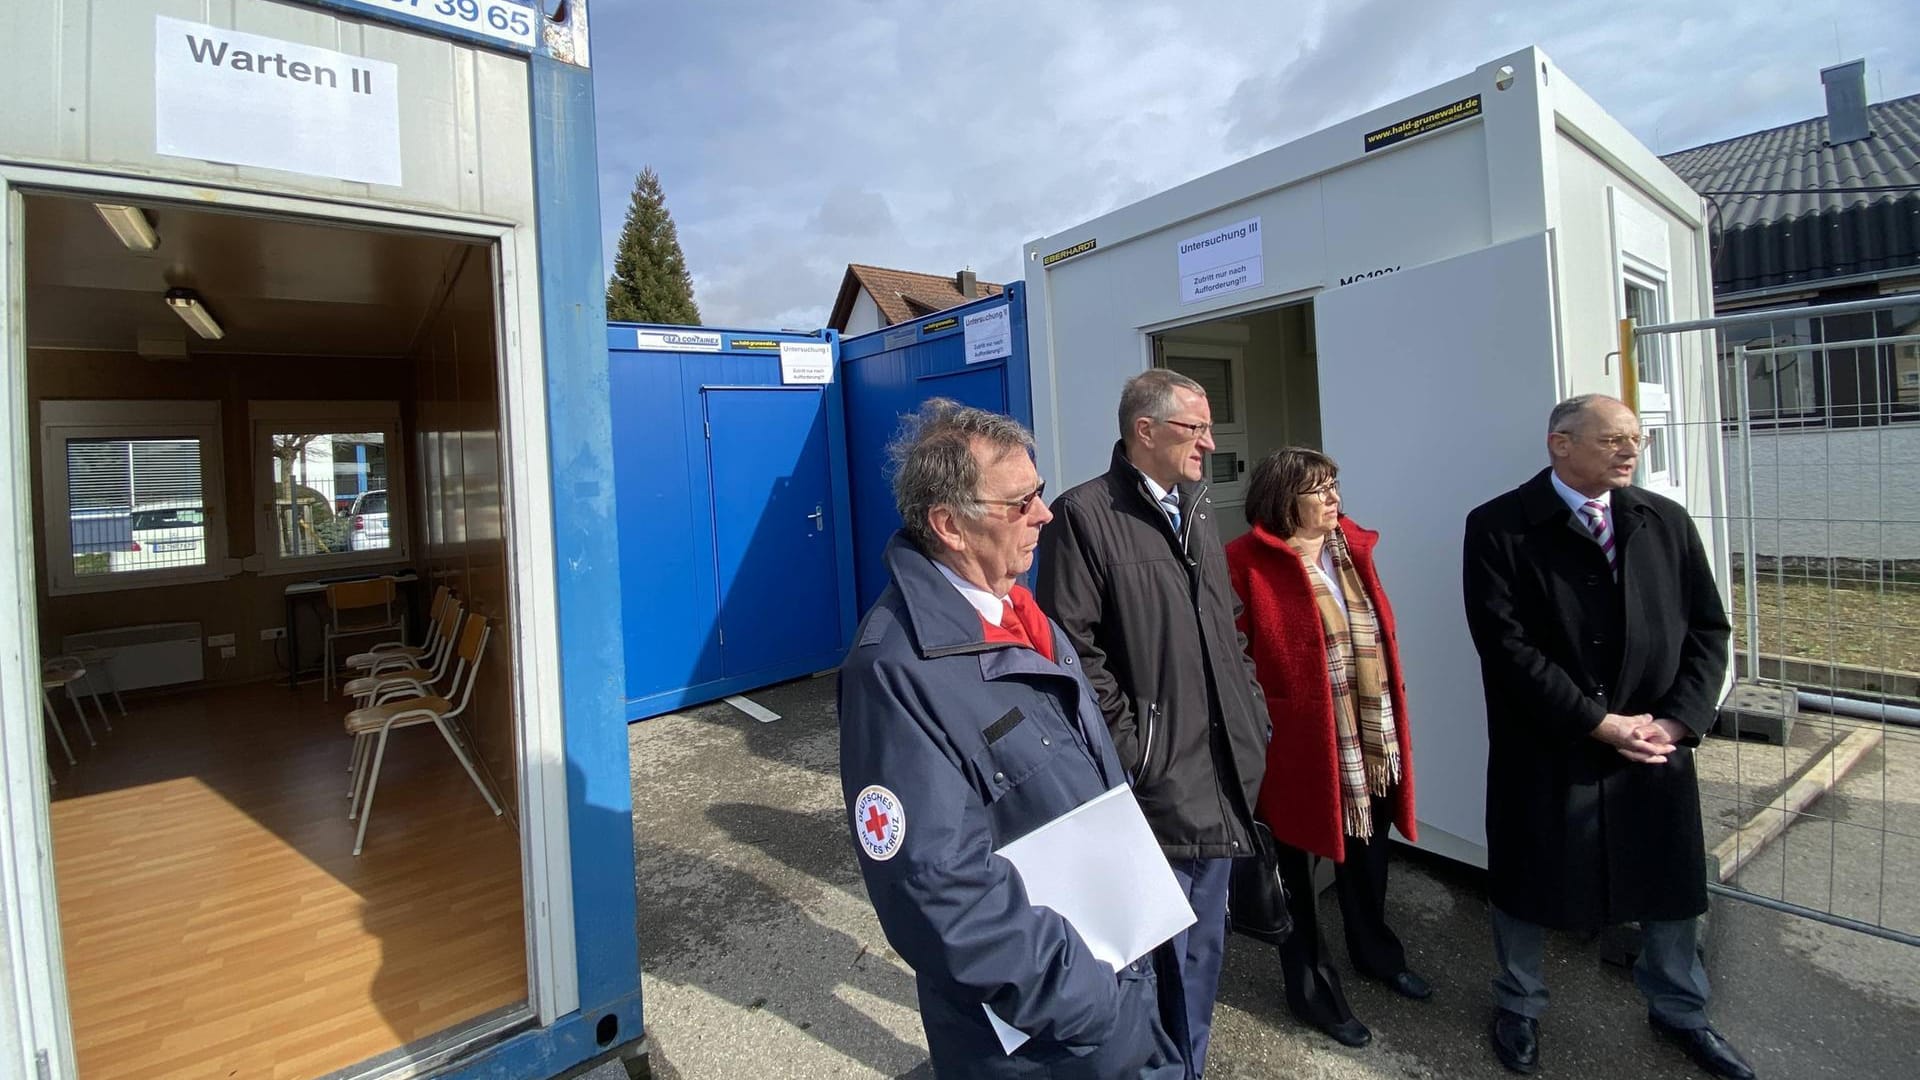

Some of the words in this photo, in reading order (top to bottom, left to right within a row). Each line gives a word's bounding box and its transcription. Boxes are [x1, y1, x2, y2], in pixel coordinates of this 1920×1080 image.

[434, 0, 479, 22] 39
[487, 6, 530, 36] 65
[186, 34, 337, 88] Warten
[352, 68, 372, 95] II
[1367, 99, 1478, 143] www.hald-grunewald.de
[1044, 240, 1095, 265] EBERHARDT
[1180, 227, 1247, 255] Untersuchung
[1249, 222, 1258, 233] III
[1193, 273, 1214, 285] Zutritt
[1215, 270, 1227, 279] nur
[1229, 265, 1247, 276] nach
[1194, 275, 1247, 295] Aufforderung!!!
[783, 346, 826, 355] Untersuchung
[859, 792, 894, 823] DEUTSCHES
[861, 831, 884, 855] ROTES
[885, 816, 900, 852] KREUZ
